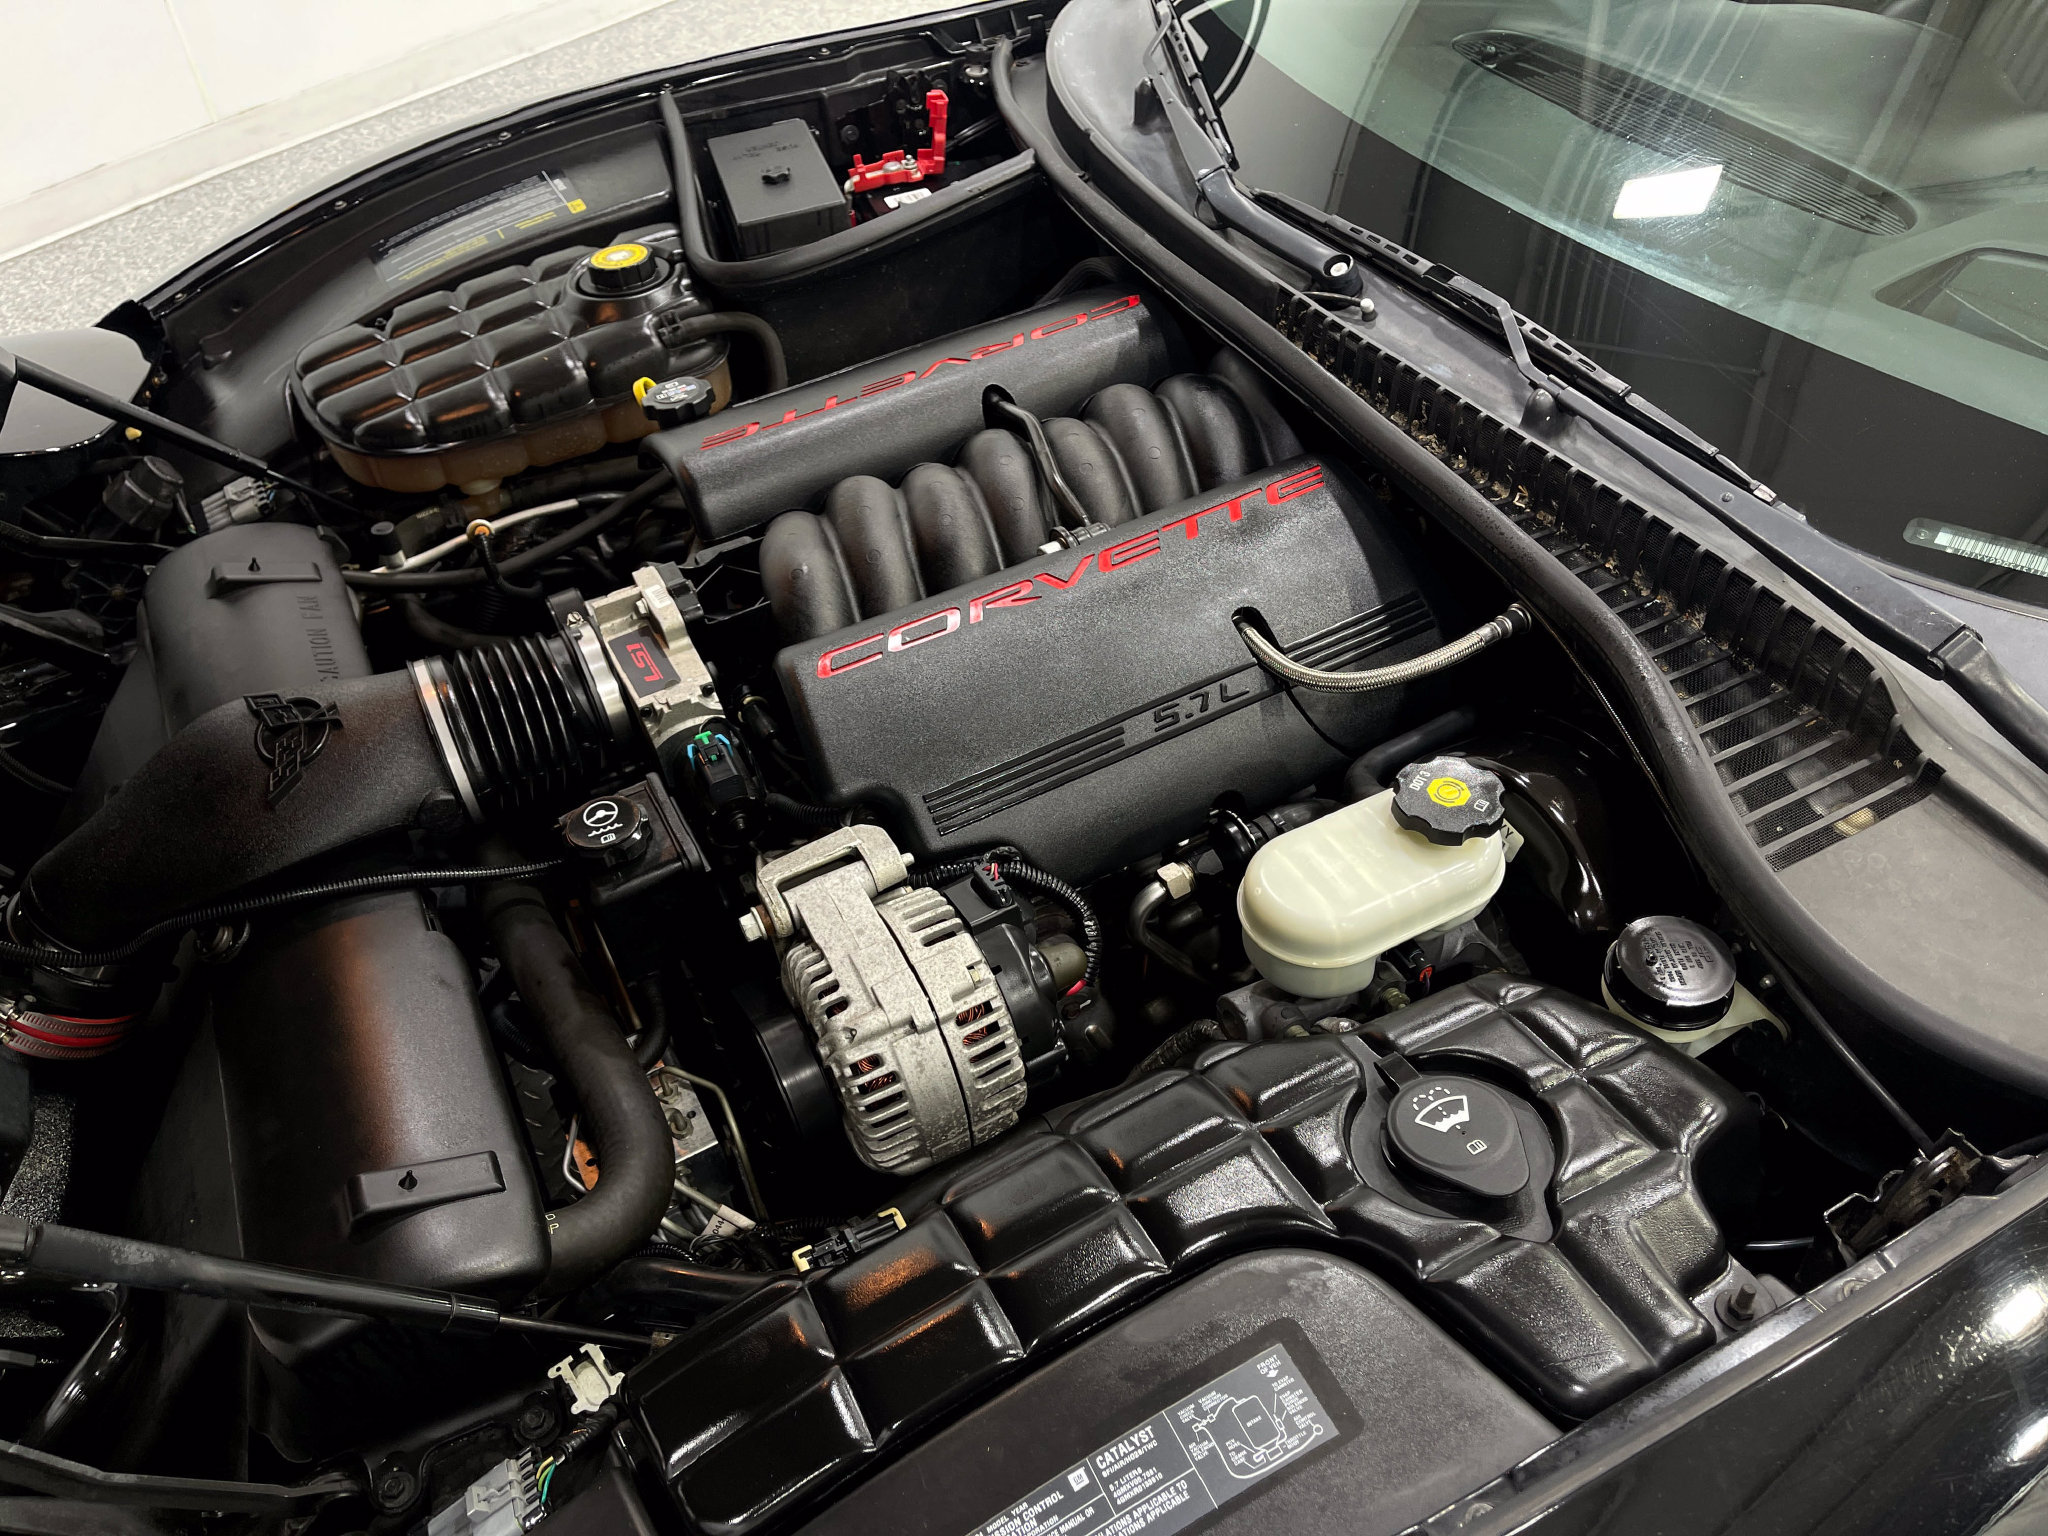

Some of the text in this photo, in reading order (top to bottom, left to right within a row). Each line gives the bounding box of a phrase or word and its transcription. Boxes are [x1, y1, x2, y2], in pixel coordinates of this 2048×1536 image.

[700, 294, 1140, 450] CORVETTE
[816, 464, 1326, 678] CORVETTE
[297, 595, 324, 620] FAN
[626, 642, 663, 682] LS1
[1409, 770, 1431, 791] DOT 3
[1256, 1354, 1278, 1370] FRONT
[1260, 1360, 1282, 1375] OF VEH
[1095, 1425, 1155, 1470] CATALYST
[1108, 1466, 1143, 1492] 5.7 LITERS
[991, 1490, 1064, 1536] SSION CONTROL
[1115, 1490, 1190, 1536] ATIONS APPLICABLE
[1132, 1484, 1177, 1520] APPLICABLE
[1176, 1479, 1188, 1493] TO
[986, 1501, 1029, 1533] MODEL YEAR
[1010, 1517, 1037, 1536] ATION
[1059, 1513, 1085, 1534] MANUAL
[1084, 1506, 1095, 1518] OR
